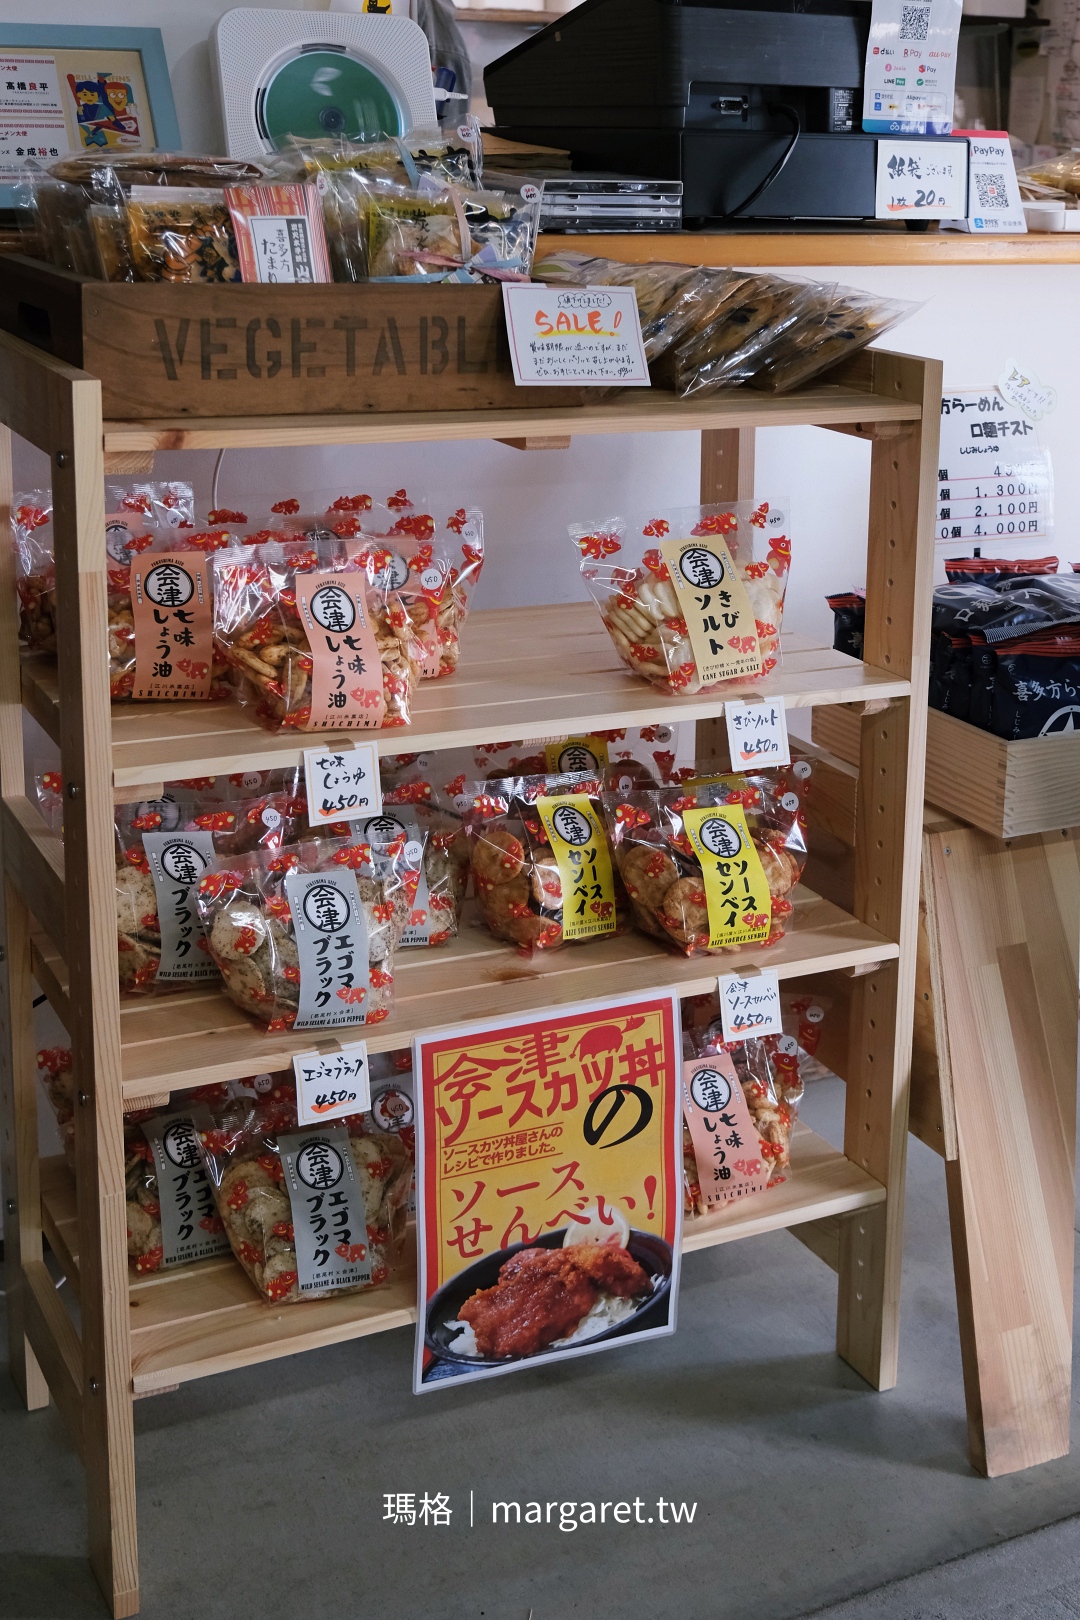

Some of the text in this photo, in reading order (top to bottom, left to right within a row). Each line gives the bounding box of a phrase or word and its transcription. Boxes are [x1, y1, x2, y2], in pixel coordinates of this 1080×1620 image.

[974, 146, 1004, 157] PayPay
[276, 229, 290, 272] 喜多方
[154, 315, 499, 380] VEGETABL
[960, 446, 1000, 454] しじみしょうゆ
[974, 520, 1038, 536] 4,000円
[976, 502, 1038, 517] 2,100円
[156, 566, 184, 606] 会津
[425, 576, 438, 584] 450
[686, 550, 718, 588] 会津
[173, 610, 196, 646] 七味
[319, 588, 350, 632] 会津
[694, 594, 724, 656] ソルト
[718, 590, 740, 628] きび
[152, 609, 173, 678] しょう油
[343, 635, 368, 675] 七味
[326, 635, 346, 708] しょう油
[702, 671, 718, 681] CANE
[746, 664, 760, 672] SALT
[138, 690, 204, 698] SHICHIMI
[313, 720, 378, 728] SHICHIMI
[316, 755, 345, 770] 七味
[744, 738, 778, 754] 450円
[324, 767, 366, 790] しょうゆ
[266, 815, 278, 823] 450
[322, 794, 368, 814] 450円
[558, 808, 587, 845] 会津
[706, 820, 736, 856] 会津
[170, 846, 198, 884] 会津
[406, 848, 418, 856] 450
[568, 850, 588, 916] センベイ
[584, 848, 603, 900] ソース
[733, 860, 758, 912] ソース
[312, 886, 342, 931] 会津
[716, 860, 738, 928] センベイ
[172, 887, 192, 958] ブラック
[312, 935, 333, 1008] ブラック
[334, 934, 354, 988] エゴマ
[734, 1013, 772, 1030] 450円
[434, 1031, 569, 1102] 会津
[315, 1090, 356, 1108] 450円
[391, 1104, 404, 1113] 450
[436, 1038, 664, 1146] ソースカツ丼
[697, 1070, 725, 1110] 会津
[583, 1084, 653, 1149] の
[720, 1112, 744, 1148] 七味
[170, 1126, 201, 1168] 会津
[444, 1126, 563, 1161] ソースカツ丼屋さんの
[444, 1145, 557, 1175] レシピで作りました。
[704, 1116, 732, 1181] しょう油
[306, 1144, 336, 1188] 会津
[172, 1170, 194, 1241] ブラック
[450, 1160, 584, 1222] ソース
[708, 1185, 763, 1202] SHICHIMI
[306, 1192, 330, 1267] ブラック
[328, 1191, 352, 1246] エゴマ
[446, 1175, 657, 1258] せんべい!
[352, 1273, 370, 1283] PEPPER
